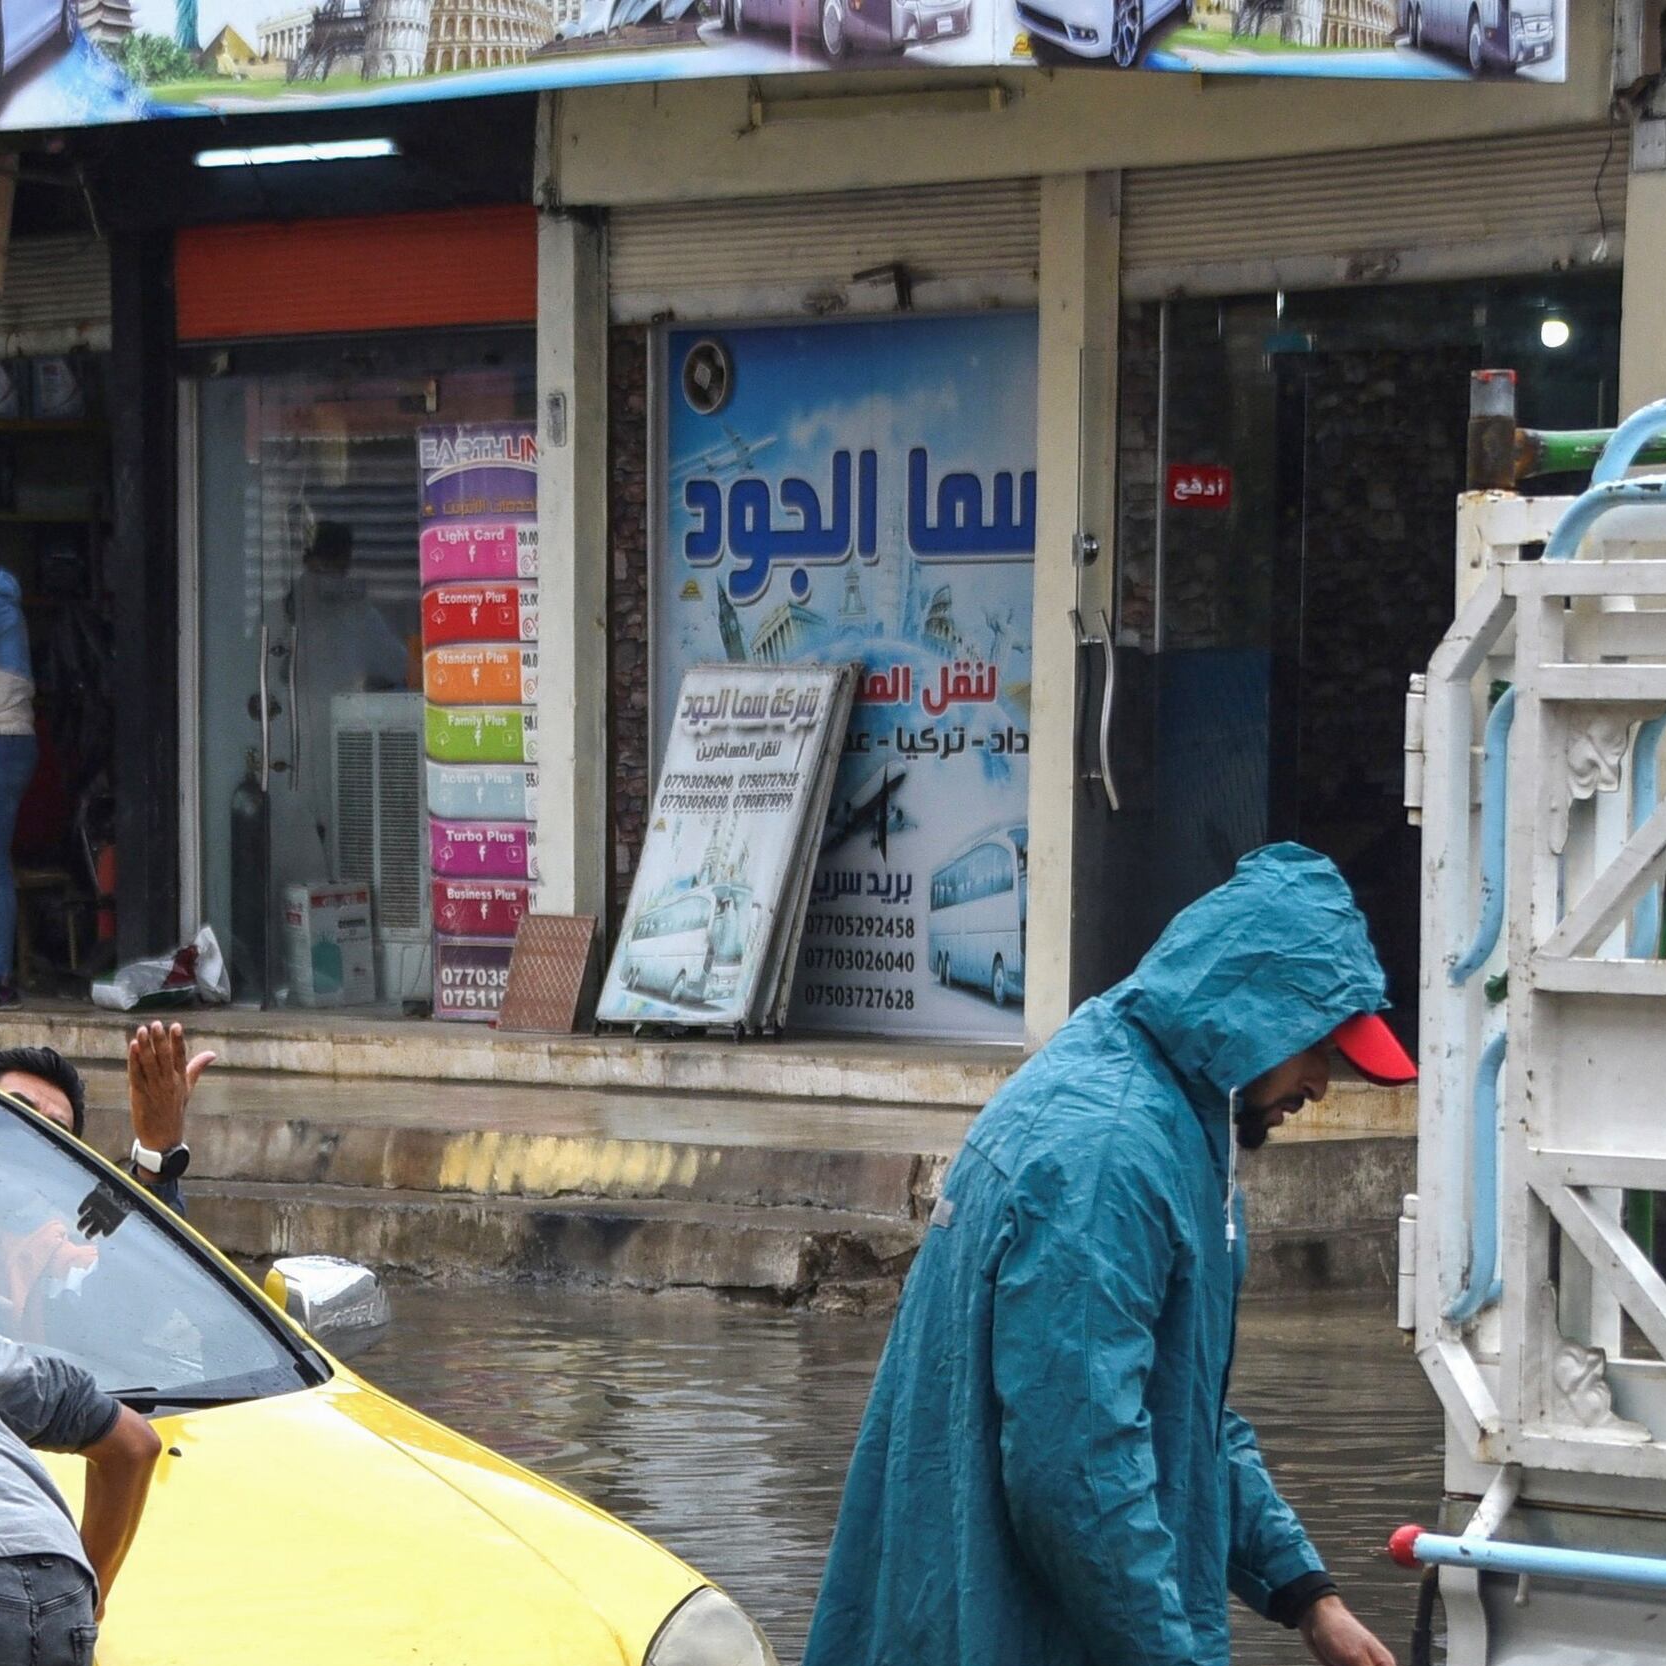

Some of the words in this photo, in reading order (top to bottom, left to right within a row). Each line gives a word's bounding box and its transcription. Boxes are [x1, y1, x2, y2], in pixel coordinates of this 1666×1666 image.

[438, 530, 470, 544] Light
[474, 528, 505, 541] Card
[684, 449, 878, 600] الجود
[438, 592, 483, 607] Economy
[486, 591, 507, 604] Plus
[436, 651, 483, 665] Standard
[486, 651, 508, 665] Plus
[923, 661, 997, 716] لنقل
[682, 689, 730, 726] الجود
[731, 689, 769, 720] سما
[770, 687, 822, 723] شركة
[448, 714, 482, 729] Family
[484, 714, 508, 727] Plus
[696, 742, 755, 762] المسافرين
[755, 741, 781, 761] لنقل
[896, 727, 965, 760] تركيا
[440, 772, 481, 784] Active
[484, 773, 512, 785] Plus
[446, 830, 483, 843] Turbo
[487, 830, 516, 843] Plus
[446, 888, 492, 901] Business
[495, 888, 517, 901] Plus
[811, 872, 861, 902] سري
[867, 873, 913, 904] بريد
[806, 915, 915, 938] 07705292458
[805, 949, 915, 972] 07703026040
[805, 985, 915, 1010] 07503727628
